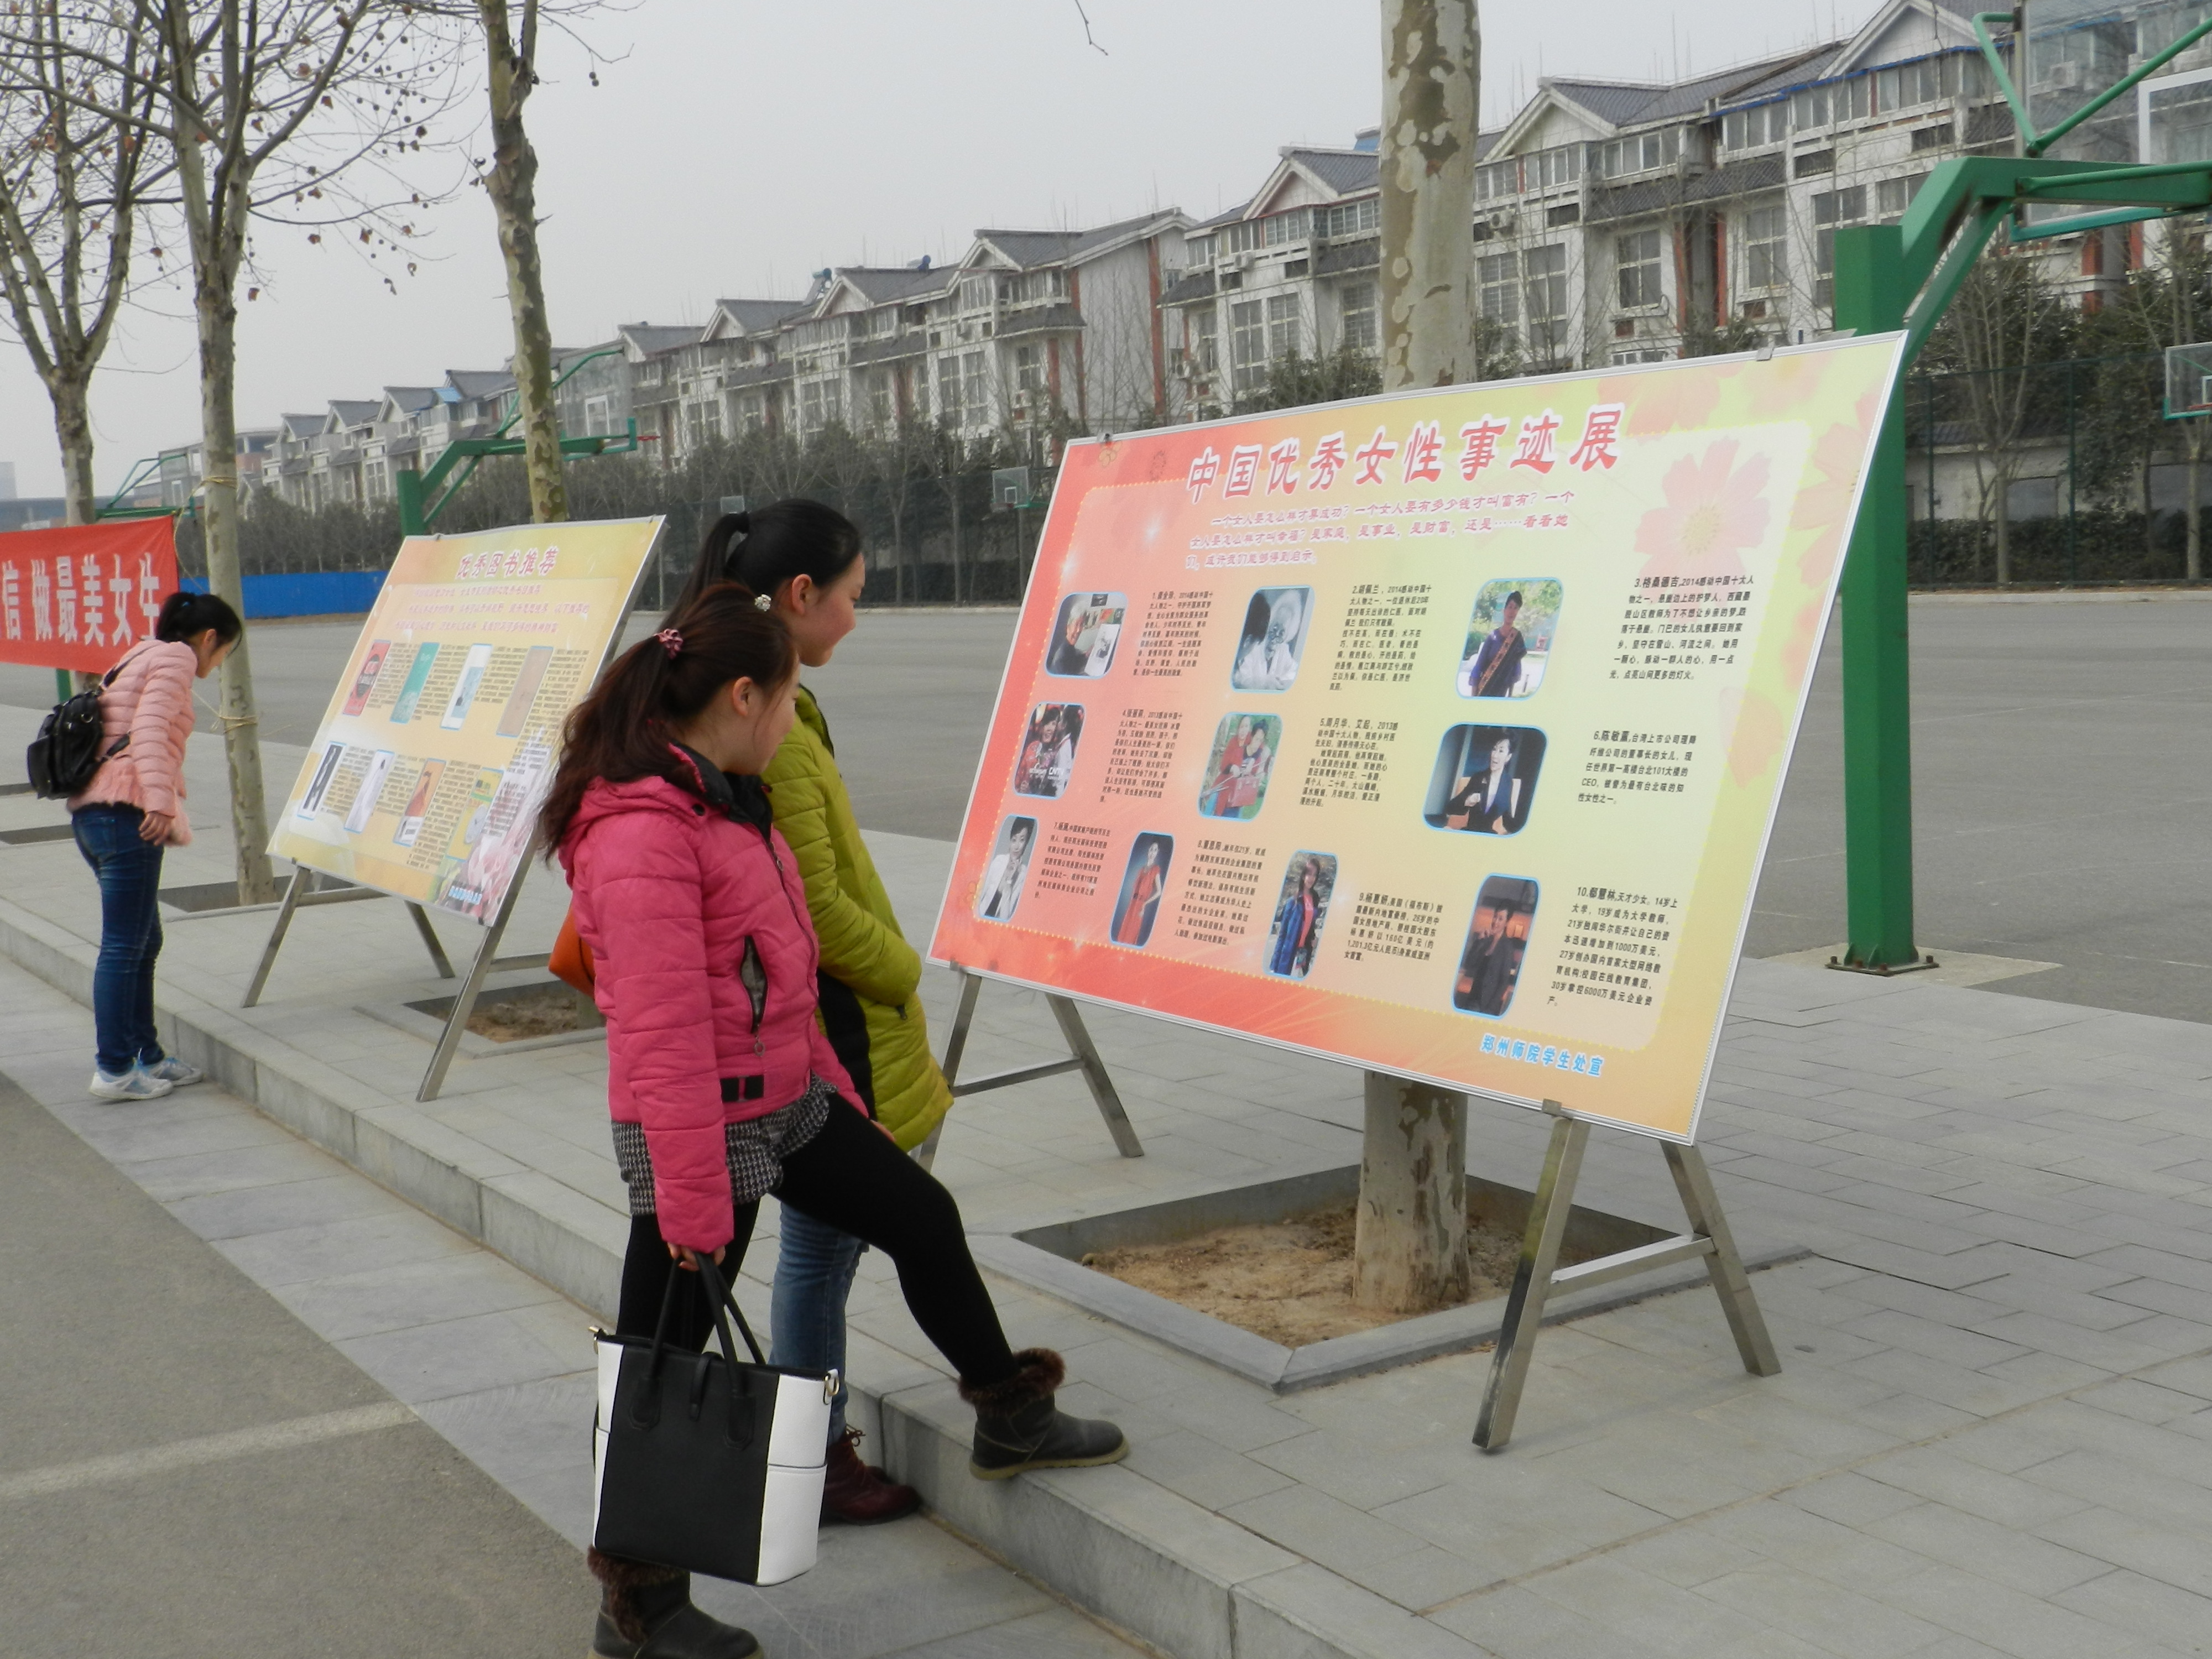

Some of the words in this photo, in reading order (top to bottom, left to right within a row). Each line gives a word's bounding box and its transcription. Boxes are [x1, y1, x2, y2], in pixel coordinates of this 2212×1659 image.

[1187, 403, 1625, 503] 中国优秀女性事迹展
[455, 545, 560, 580] 优秀图书推荐
[1547, 996, 1557, 1006] 产。
[1480, 1032, 1604, 1077] 郑州师院学生处宣
